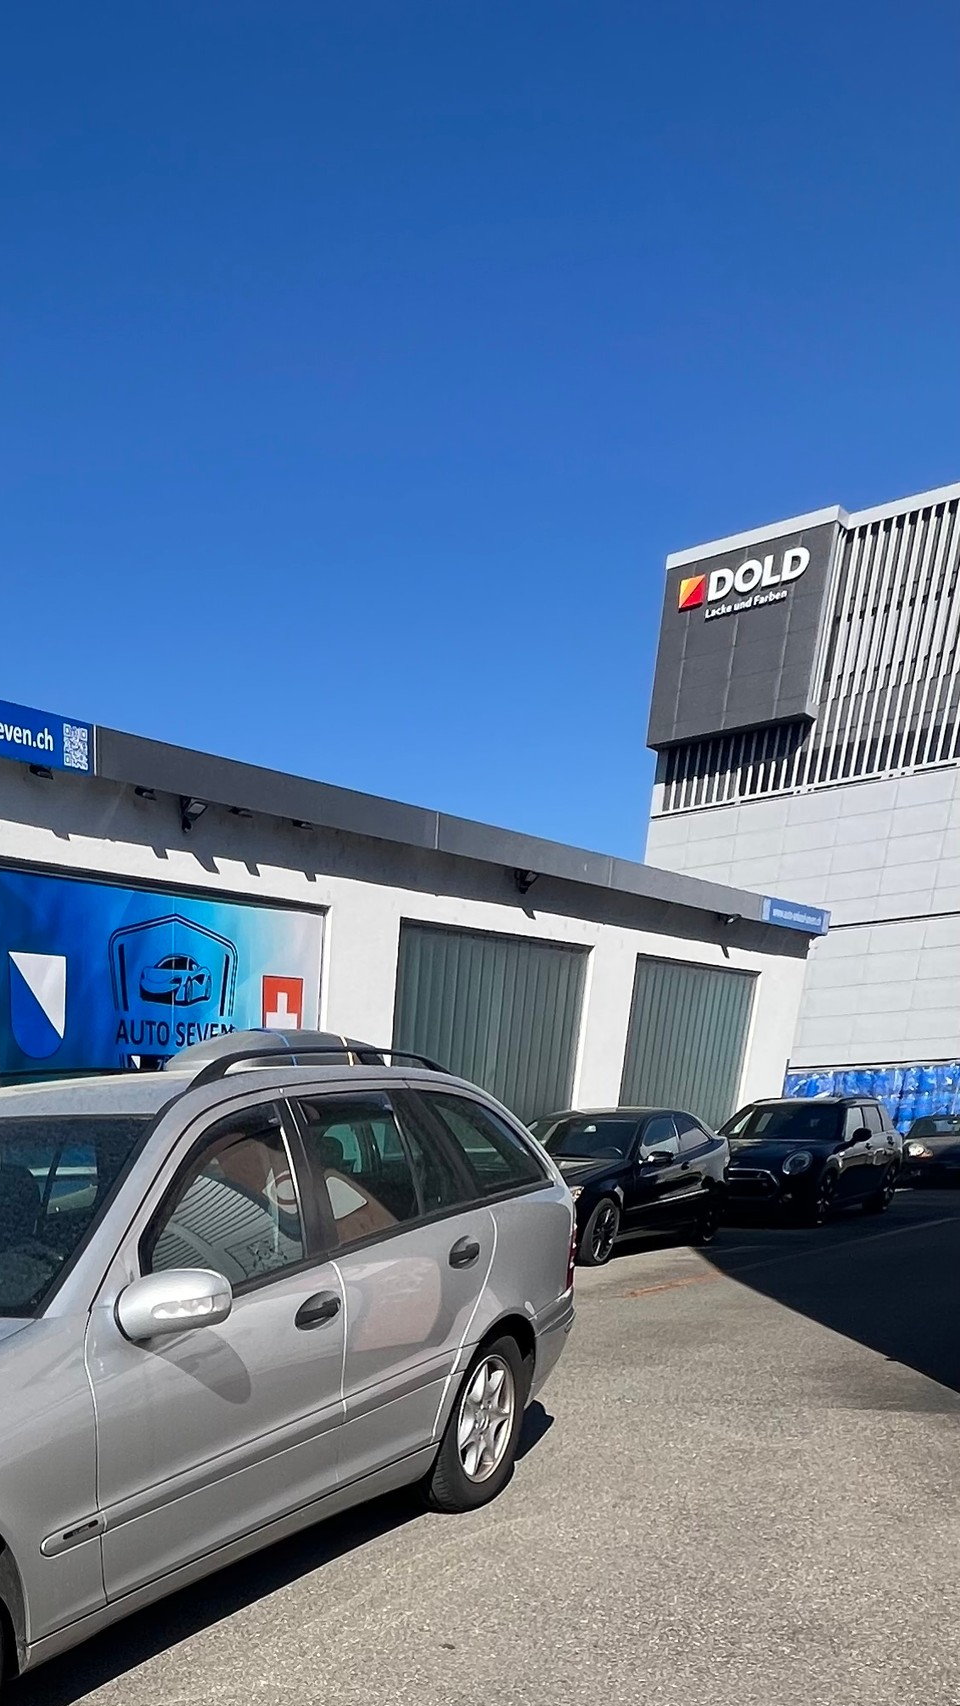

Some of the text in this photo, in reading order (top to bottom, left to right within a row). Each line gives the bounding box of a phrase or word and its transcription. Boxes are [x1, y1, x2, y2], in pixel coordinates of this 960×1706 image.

[707, 547, 810, 601] DOLD
[705, 590, 788, 619] Lacke und Farben
[115, 1019, 169, 1046] AUTO
